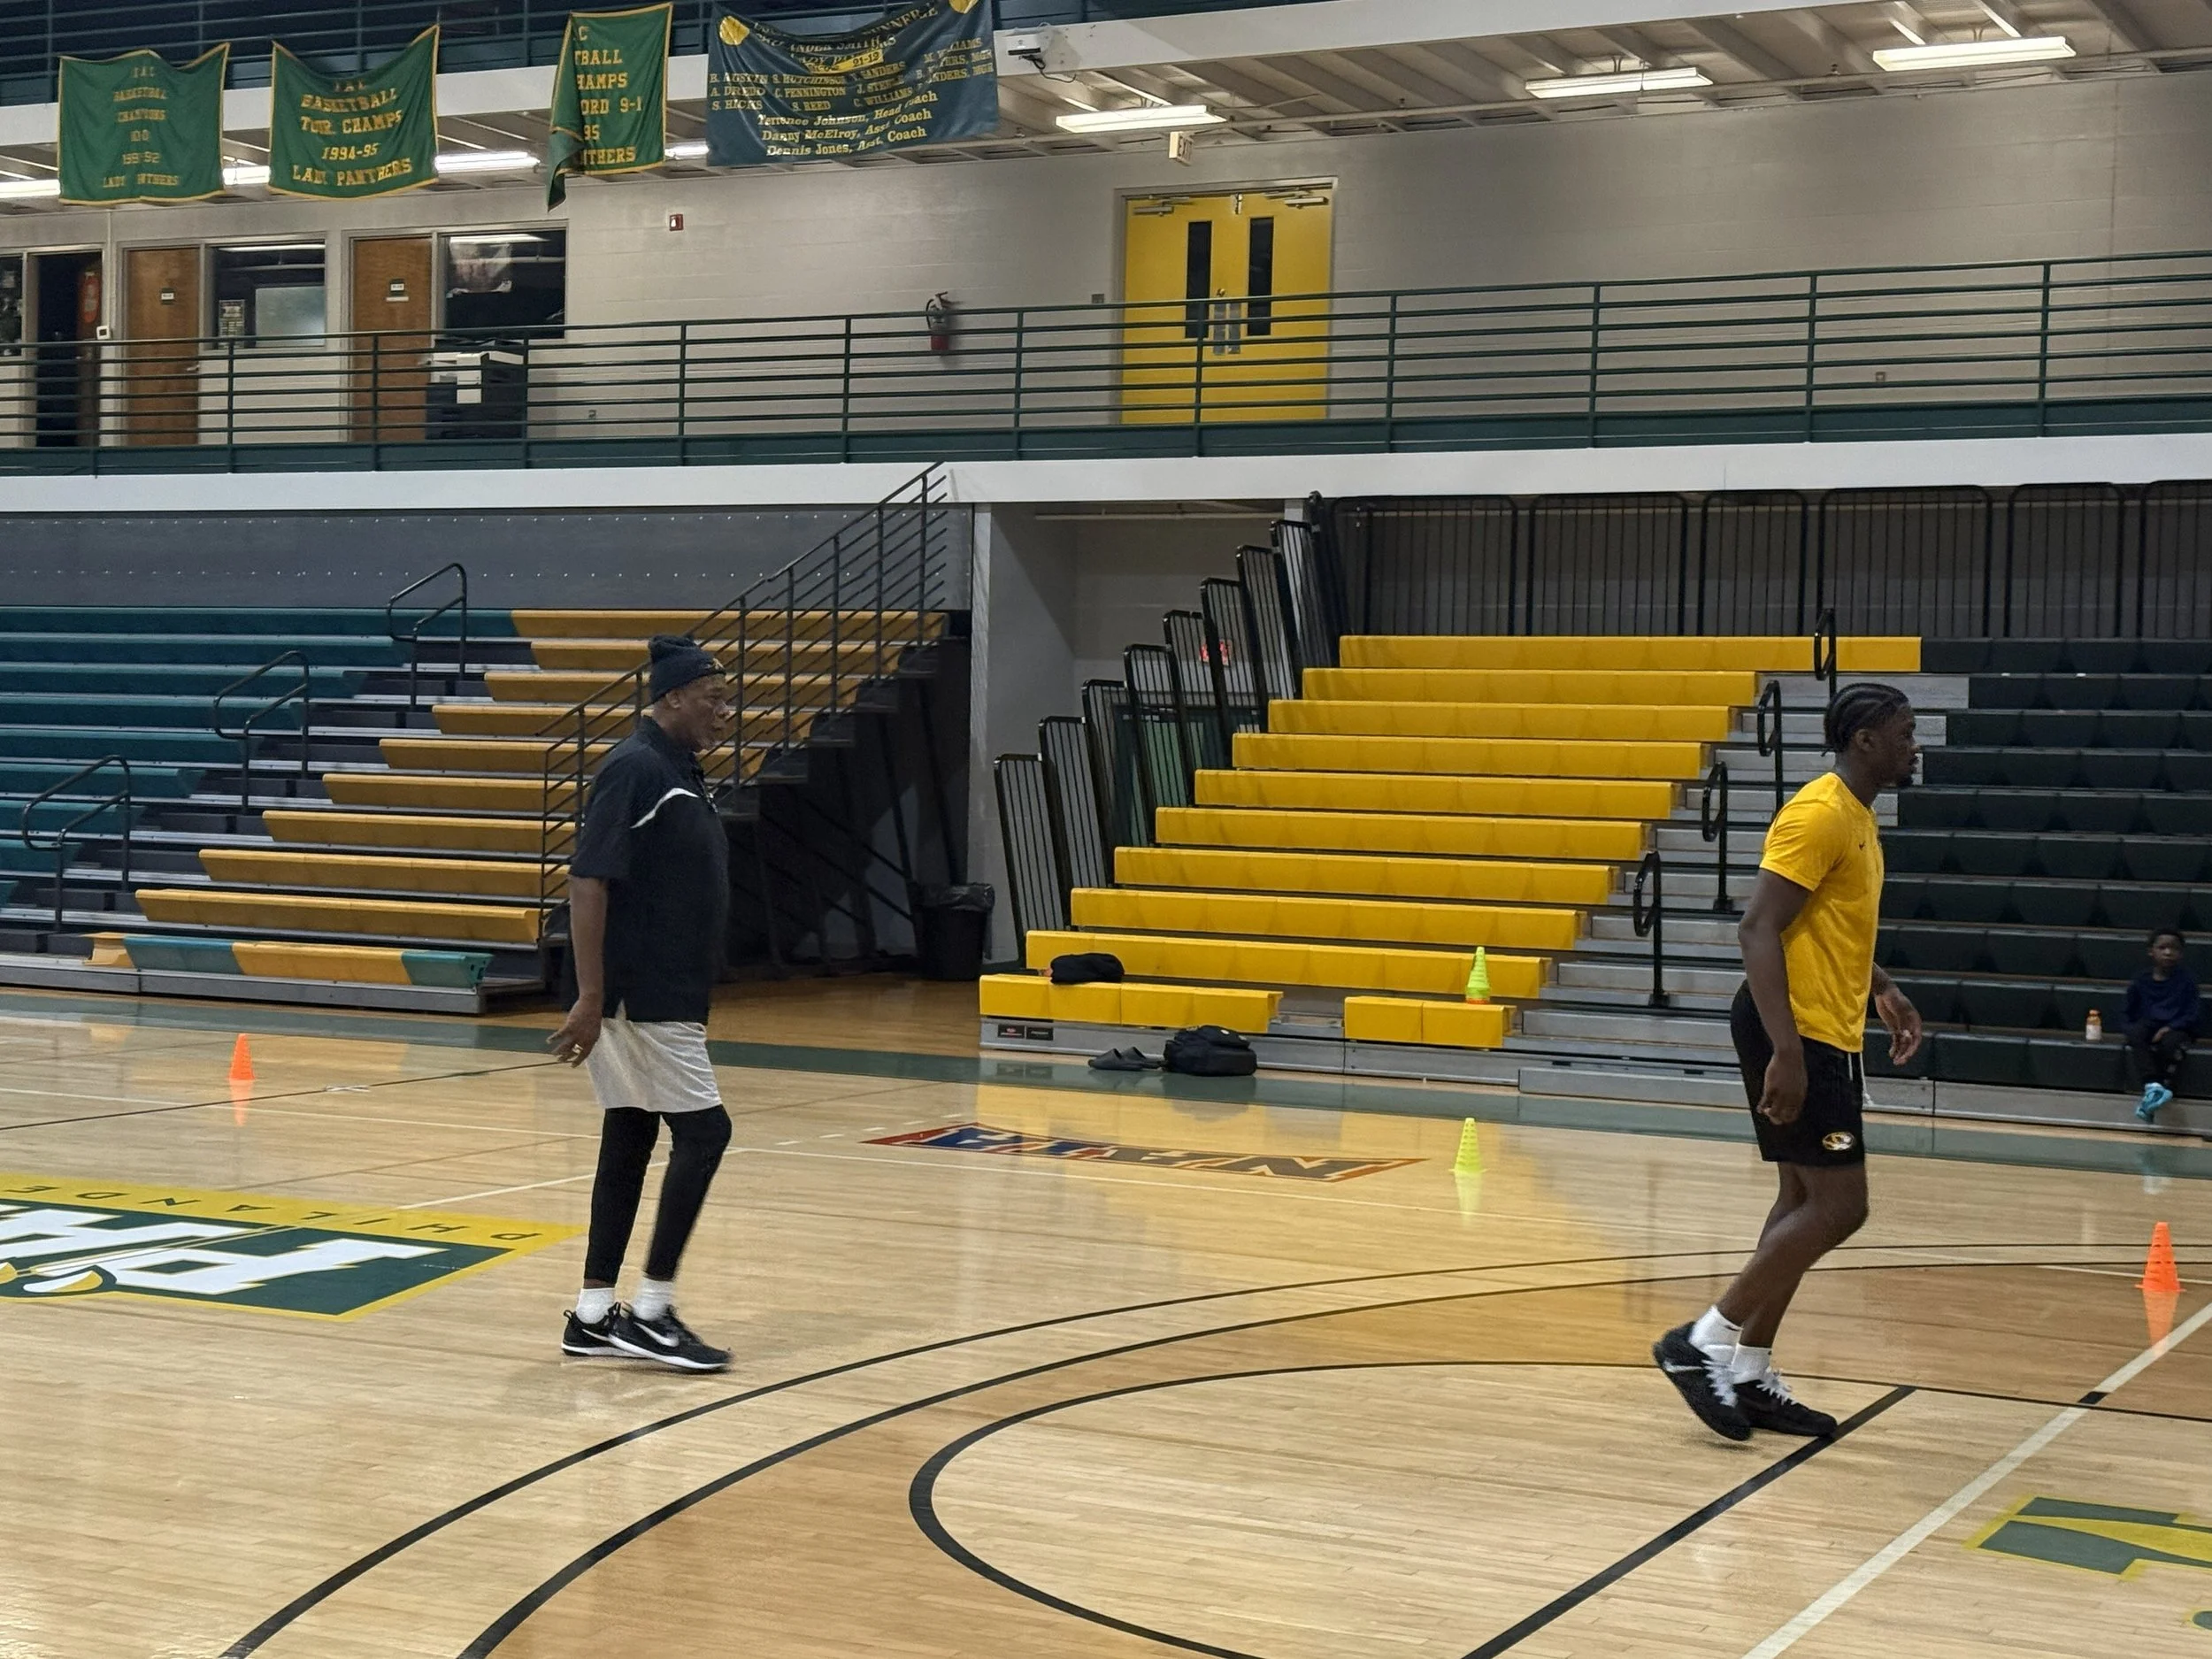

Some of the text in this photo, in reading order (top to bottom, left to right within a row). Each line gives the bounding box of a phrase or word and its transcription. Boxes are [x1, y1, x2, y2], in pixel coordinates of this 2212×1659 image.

[852, 52, 880, 66] 21-12
[785, 87, 846, 98] PENNINGTON
[619, 96, 642, 112] 9-1
[873, 103, 902, 120] Head
[342, 110, 403, 134] CHAMPS
[762, 129, 801, 143] Danny
[895, 107, 932, 124] Coach
[766, 144, 811, 157] Dennis
[815, 142, 853, 156] Jones,
[887, 125, 927, 142] Coach
[322, 142, 381, 160] 1994-95
[336, 157, 411, 186] PANTHERS
